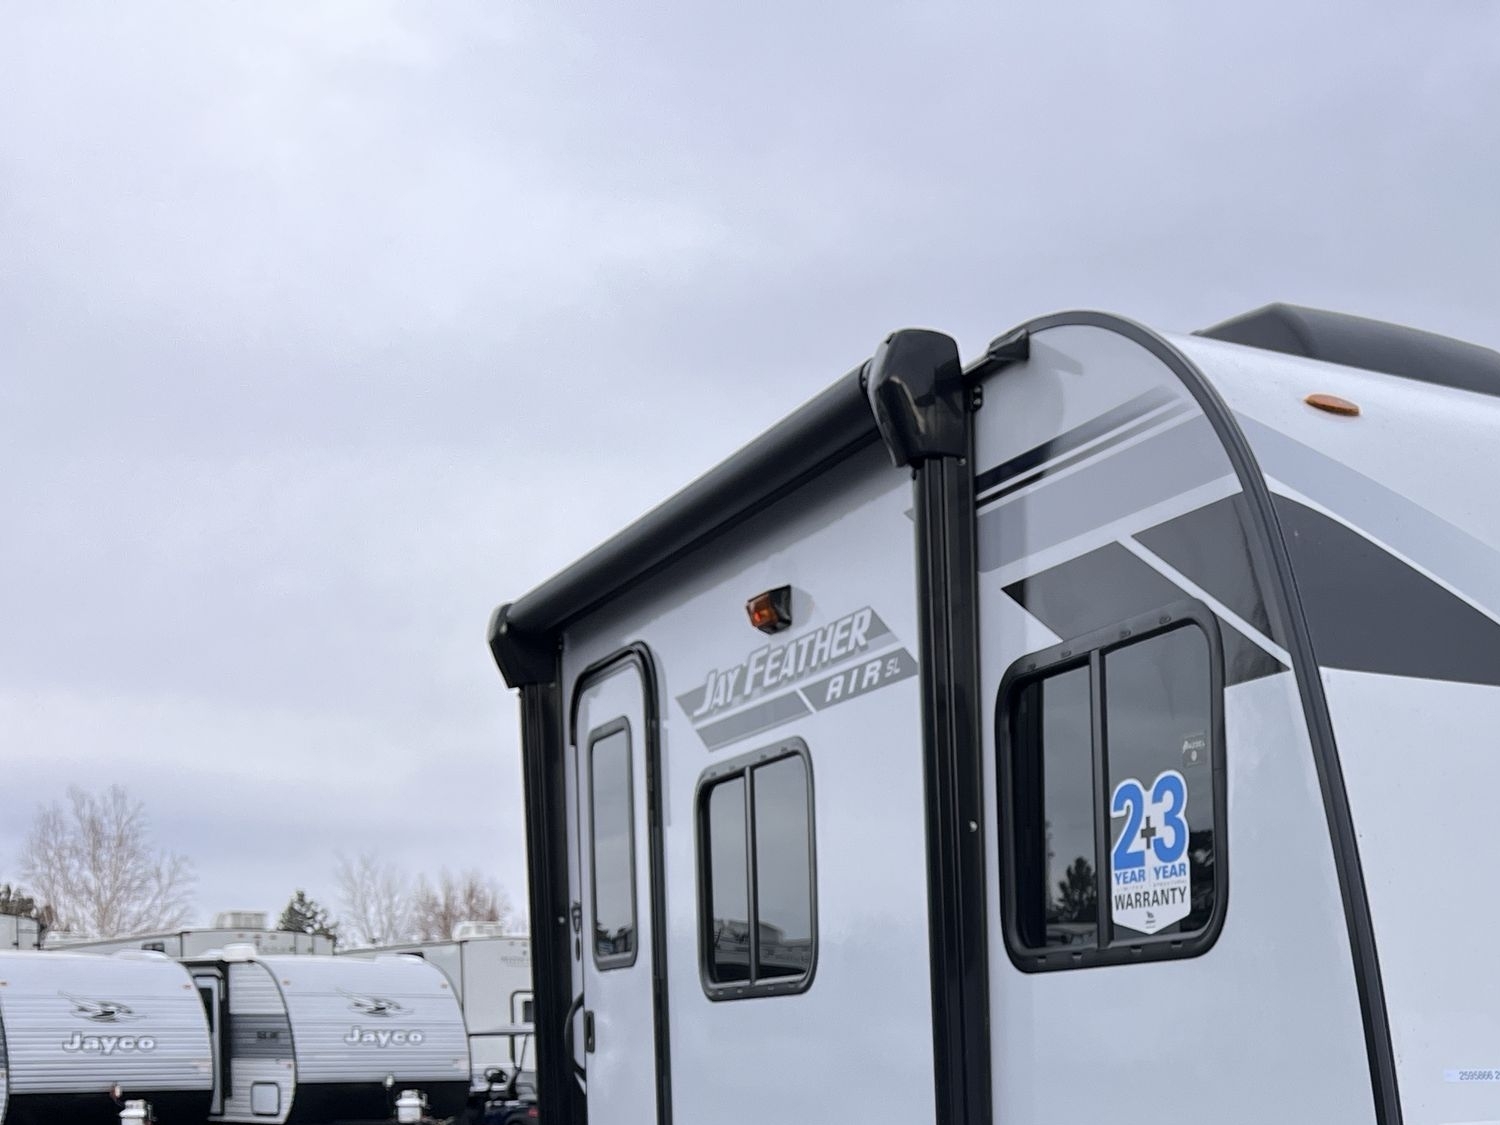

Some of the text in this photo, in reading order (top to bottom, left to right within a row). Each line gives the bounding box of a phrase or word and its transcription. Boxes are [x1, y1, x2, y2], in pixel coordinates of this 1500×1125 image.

[693, 611, 872, 716] JAY FEATHER
[825, 657, 901, 702] AIR SL
[1114, 863, 1187, 885] YEAR YEAR
[1114, 886, 1187, 911] WARRANTY
[62, 1032, 157, 1055] Jayco
[344, 1025, 425, 1047] Jayco
